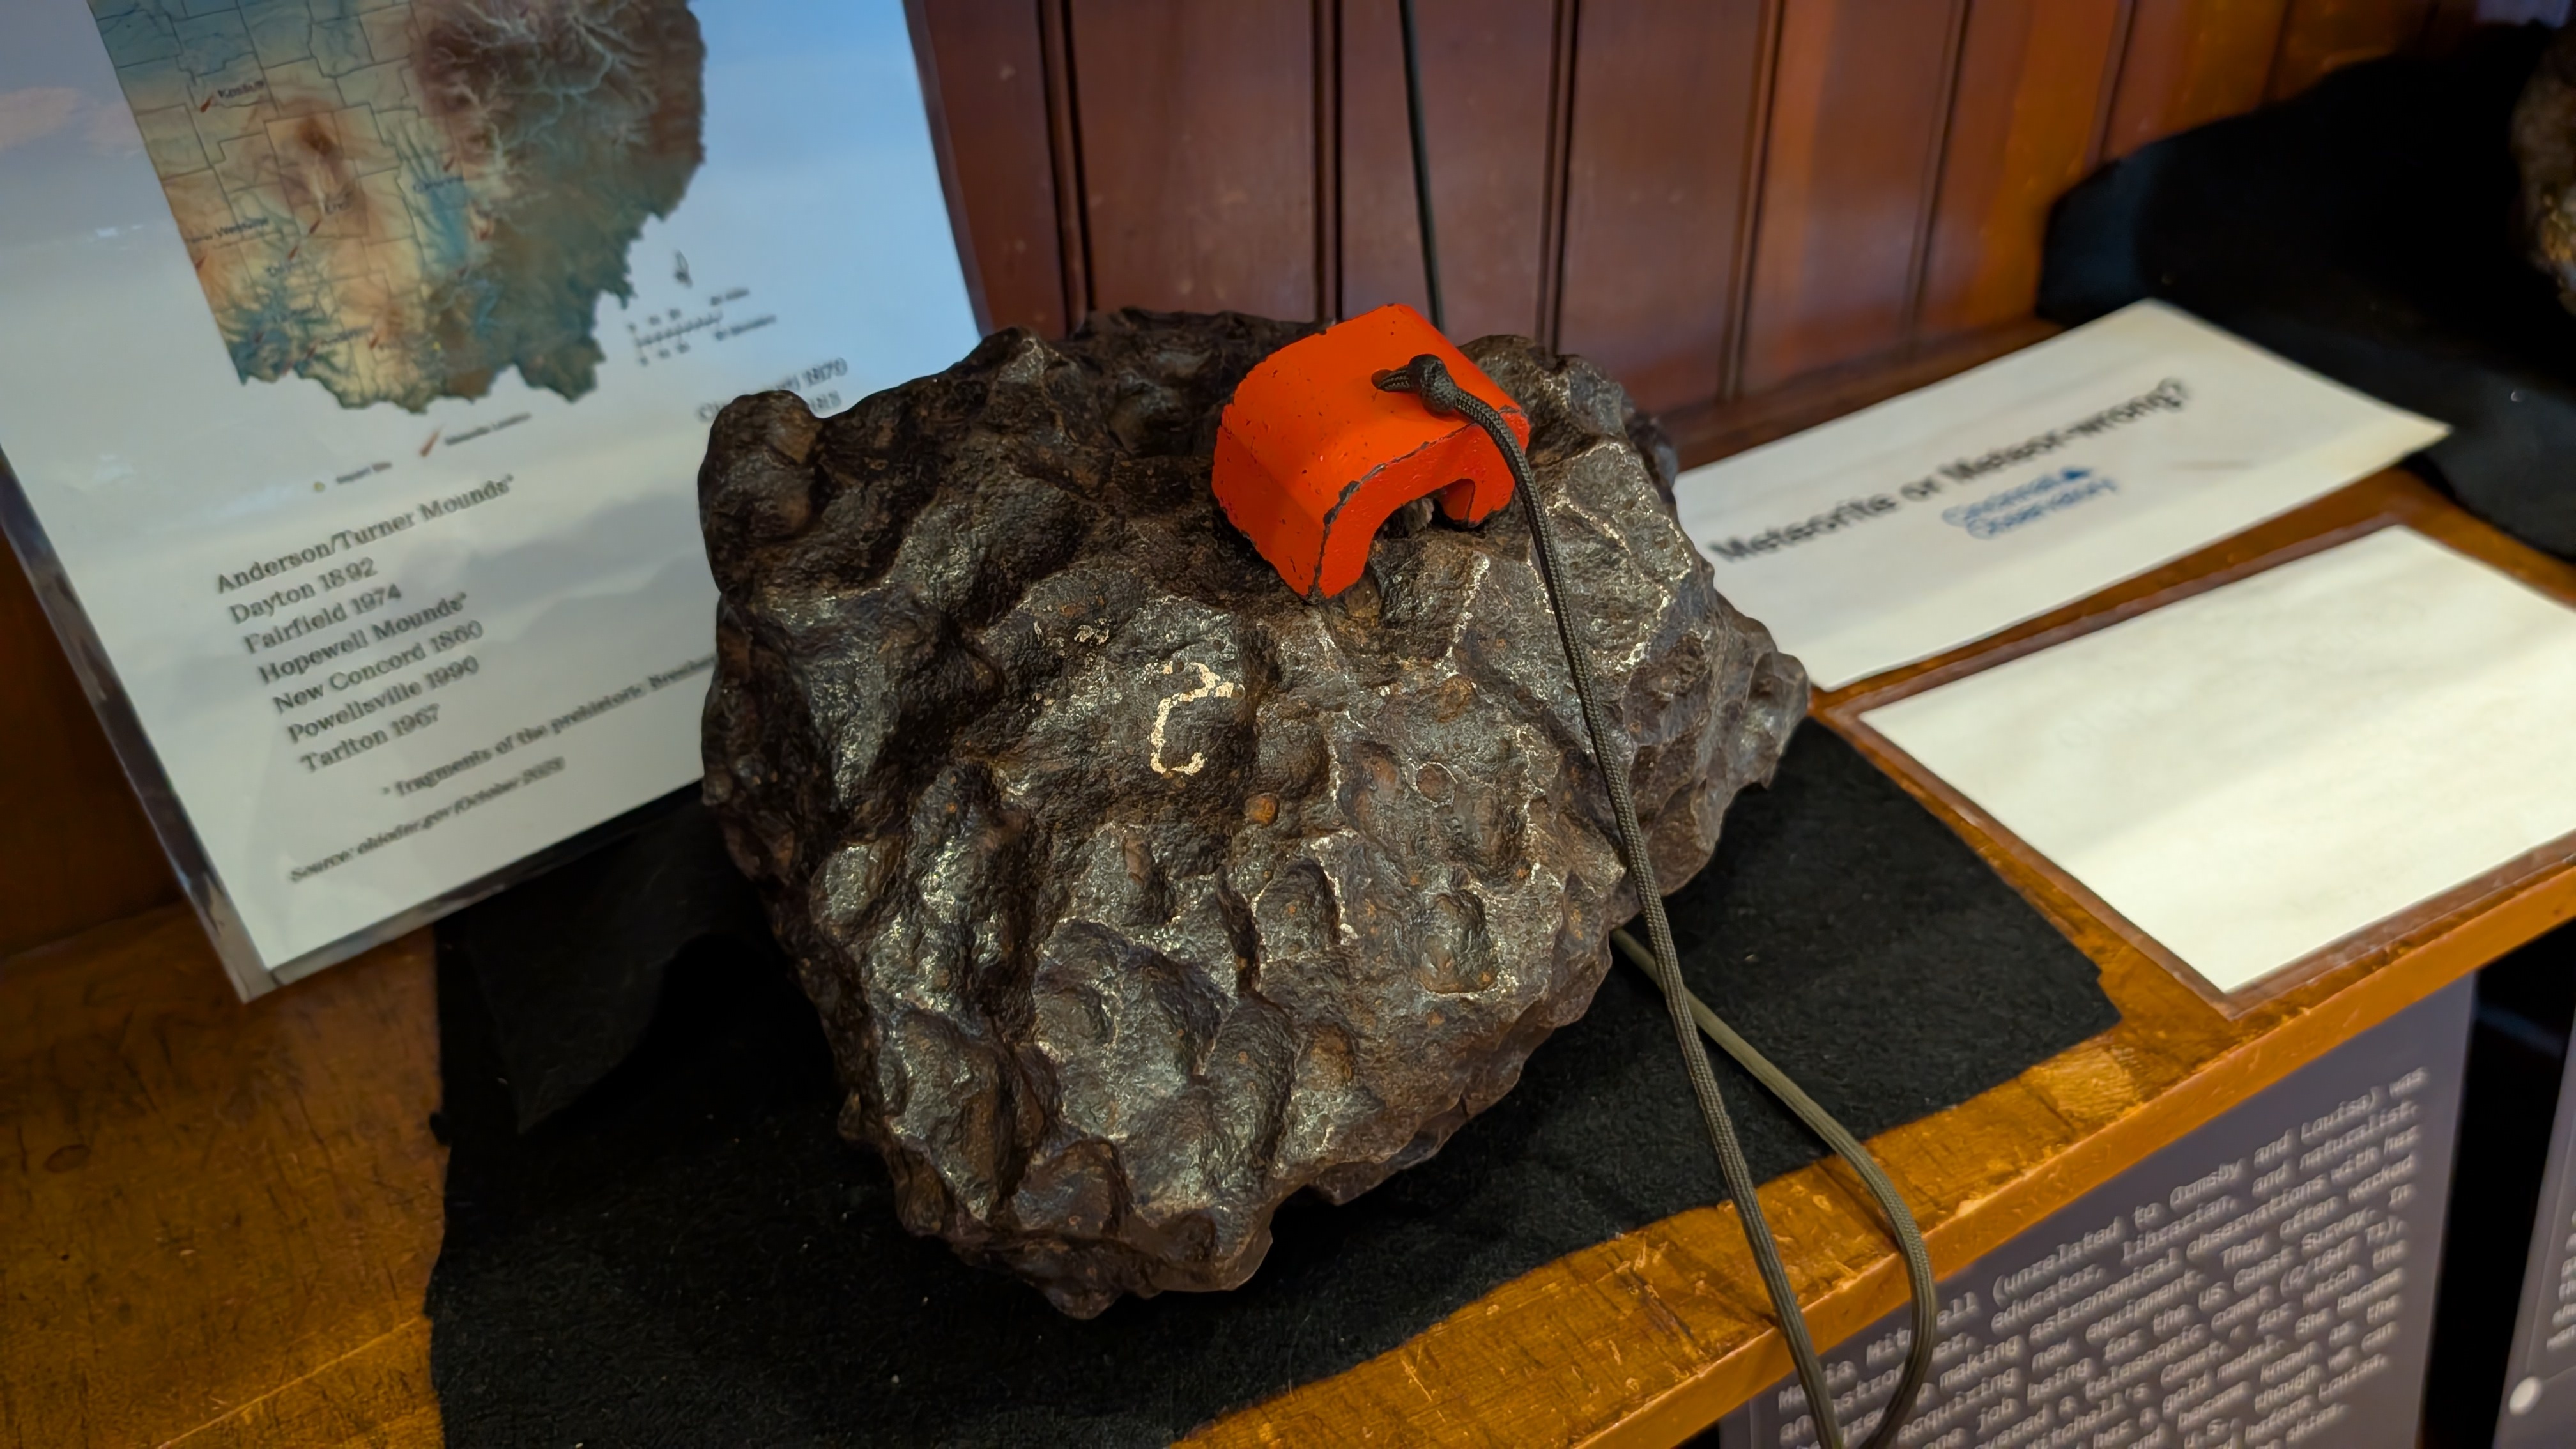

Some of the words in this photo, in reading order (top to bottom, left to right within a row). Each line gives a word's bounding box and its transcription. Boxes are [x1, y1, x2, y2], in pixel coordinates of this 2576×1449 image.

[217, 510, 415, 594] Anderson/Turner
[1708, 494, 1897, 562] Meteorite
[1900, 477, 1941, 502] or
[228, 581, 316, 625] Dayton
[319, 557, 378, 592] 1892
[245, 602, 348, 654] Fairfield
[351, 583, 402, 615] 1974
[259, 629, 369, 684] Hopewell
[273, 684, 324, 714] New
[328, 642, 426, 690] Concord
[288, 682, 422, 743] Powellsville
[300, 730, 388, 771] Tarlton
[394, 749, 492, 796] fragments
[494, 735, 514, 755] of
[516, 726, 548, 745] the
[1779, 1361, 1857, 1413] Maia
[1866, 1292, 1979, 1368] Mitell
[1993, 1216, 2126, 1307] (unrelated
[2135, 1203, 2165, 1230] to
[2170, 1158, 2250, 1211] Ormsby
[2254, 1128, 2298, 1169] and
[2301, 1087, 2386, 1144] Louisa)
[2389, 1068, 2428, 1098] was
[1940, 1335, 2023, 1389] making
[2029, 1248, 2182, 1345] astronomical
[2187, 1172, 2329, 1259] observations
[2331, 1147, 2379, 1182] with
[2384, 1126, 2419, 1155] her
[1991, 1264, 2106, 1336] educator,
[2252, 1158, 2295, 1199] and
[1897, 1367, 2021, 1446] acquiring
[2032, 1337, 2075, 1374] new
[2222, 1232, 2271, 1273] They
[2280, 1196, 2339, 1240] often
[2348, 1152, 2416, 1202] worked
[2258, 1301, 2297, 1335] for
[2303, 1265, 2362, 1308] which
[2373, 1239, 2407, 1270] the
[1976, 1396, 2018, 1444] job
[2027, 1358, 2094, 1405] being
[2104, 1329, 2142, 1365] for
[2154, 1305, 2191, 1338] the
[2199, 1282, 2228, 1312] US
[2086, 1324, 2205, 1400] telescopic
[2211, 1285, 2273, 1332] comet
[2162, 1370, 2212, 1419] gold
[2295, 1307, 2330, 1340] She
[2260, 1340, 2321, 1386] known
[2367, 1294, 2402, 1326] the
